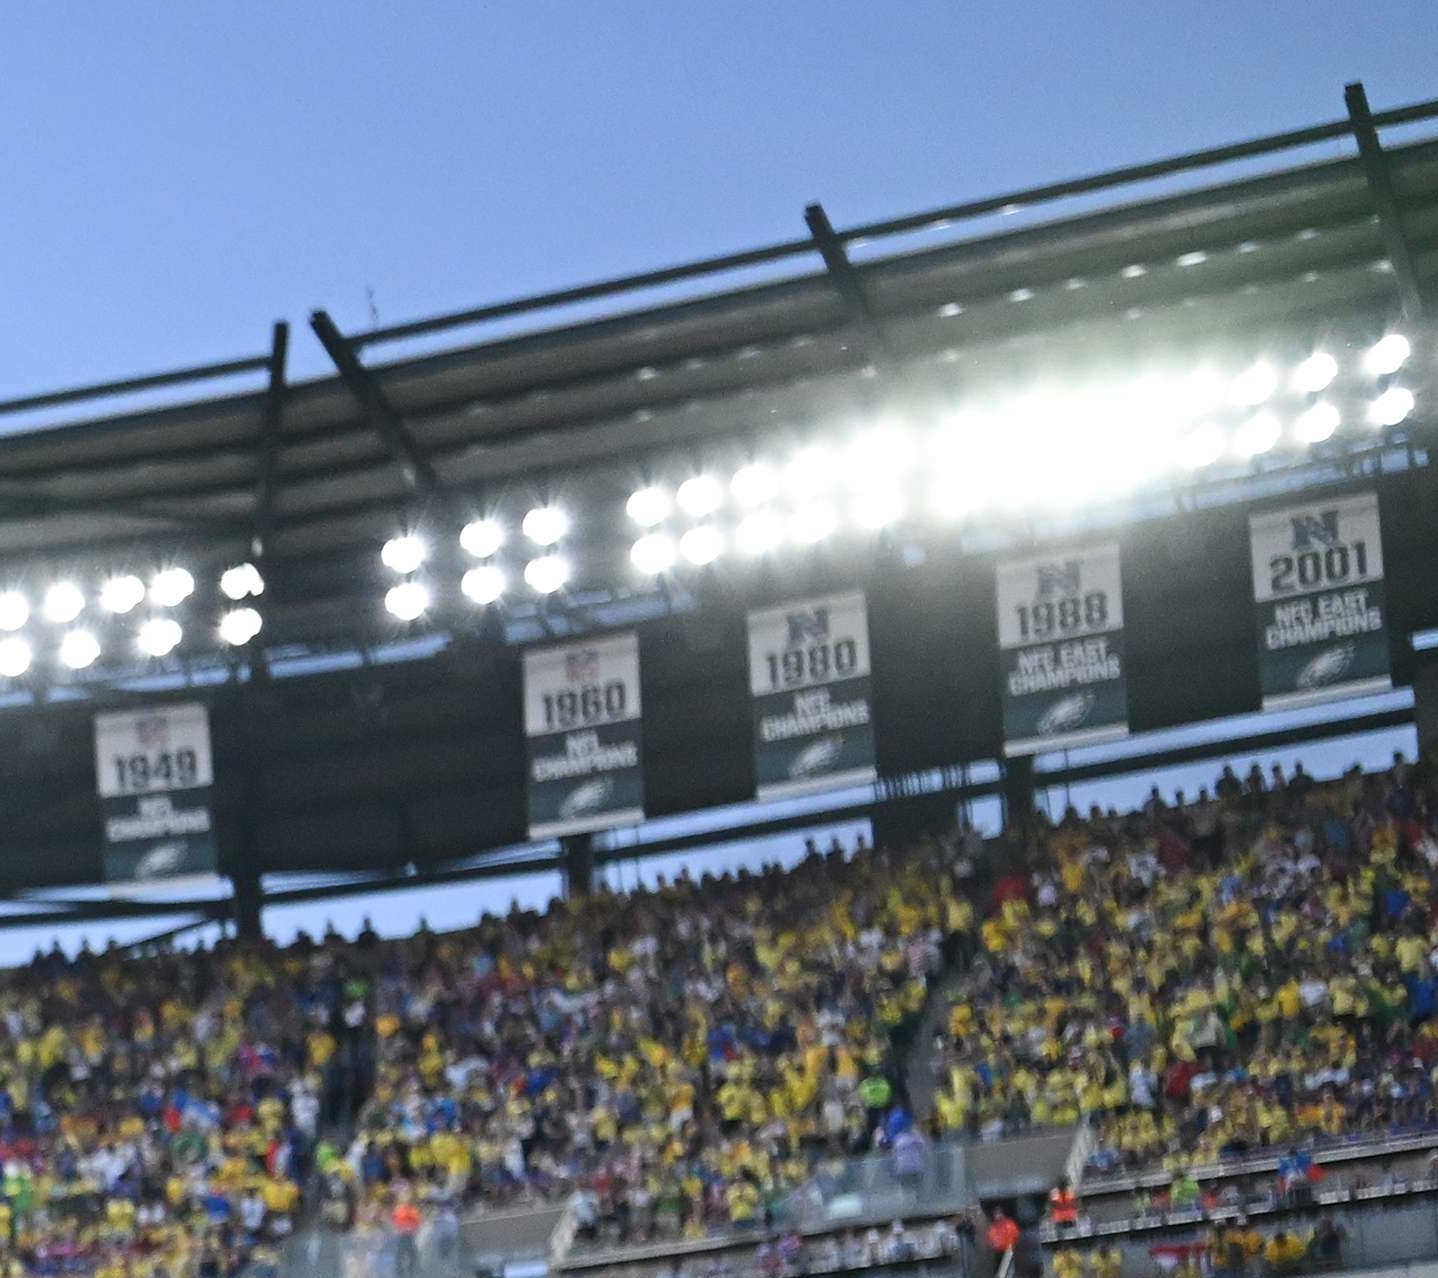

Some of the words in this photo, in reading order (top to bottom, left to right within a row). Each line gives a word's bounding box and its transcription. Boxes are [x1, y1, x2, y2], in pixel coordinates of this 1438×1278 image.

[1268, 542, 1370, 595] 2001
[1014, 590, 1109, 642] 1988
[1318, 589, 1370, 617] EAST
[1265, 606, 1383, 652] CHAMPIONS
[765, 638, 859, 690] 1980
[1008, 652, 1122, 697] CHAMPIONS
[541, 680, 627, 730] 1960
[759, 699, 872, 743] CHAMPIONS
[113, 747, 198, 791] 1949
